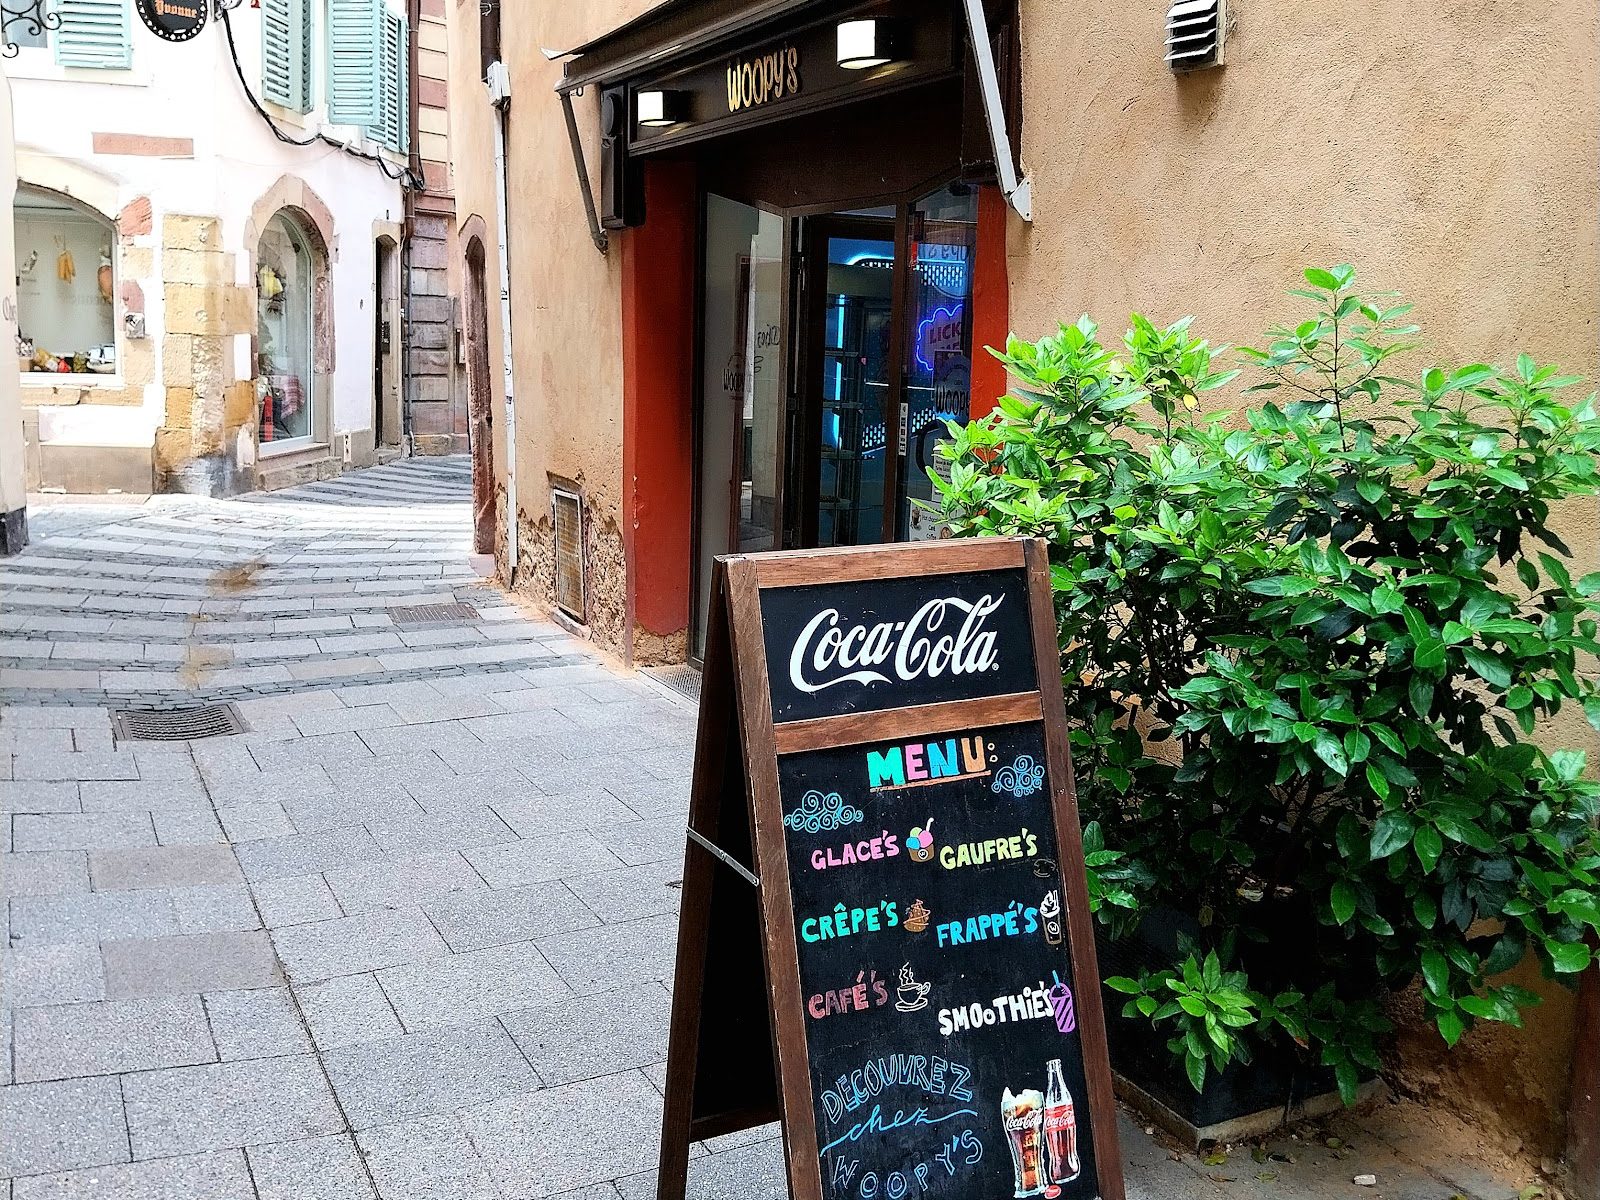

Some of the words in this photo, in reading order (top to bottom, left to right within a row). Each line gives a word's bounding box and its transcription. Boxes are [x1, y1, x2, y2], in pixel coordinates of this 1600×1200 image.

[866, 736, 998, 787] MENU:
[811, 830, 900, 870] GLACE'S
[939, 827, 1038, 870] GAUFRE'S
[801, 900, 899, 943] CRÊPE'S
[936, 900, 1038, 948] FRAPPÉ'S
[808, 970, 888, 1019] CAFÉ'S
[832, 1129, 983, 1199] WOOPY'S
